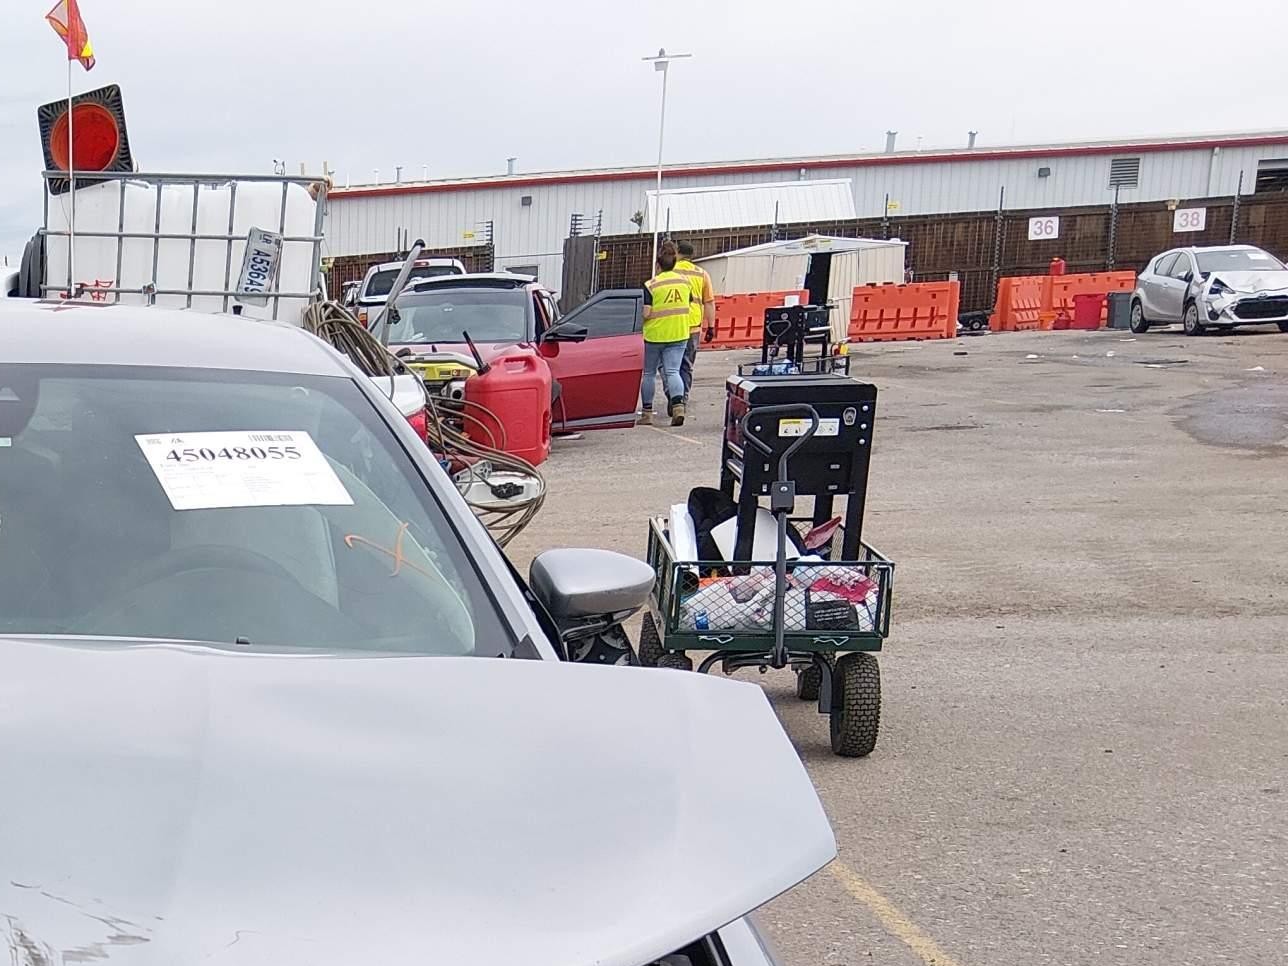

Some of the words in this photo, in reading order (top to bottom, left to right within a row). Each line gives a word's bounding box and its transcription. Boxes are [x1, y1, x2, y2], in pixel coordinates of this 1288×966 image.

[1179, 212, 1200, 227] 38
[1033, 220, 1053, 236] 36
[166, 446, 302, 463] 45048055
